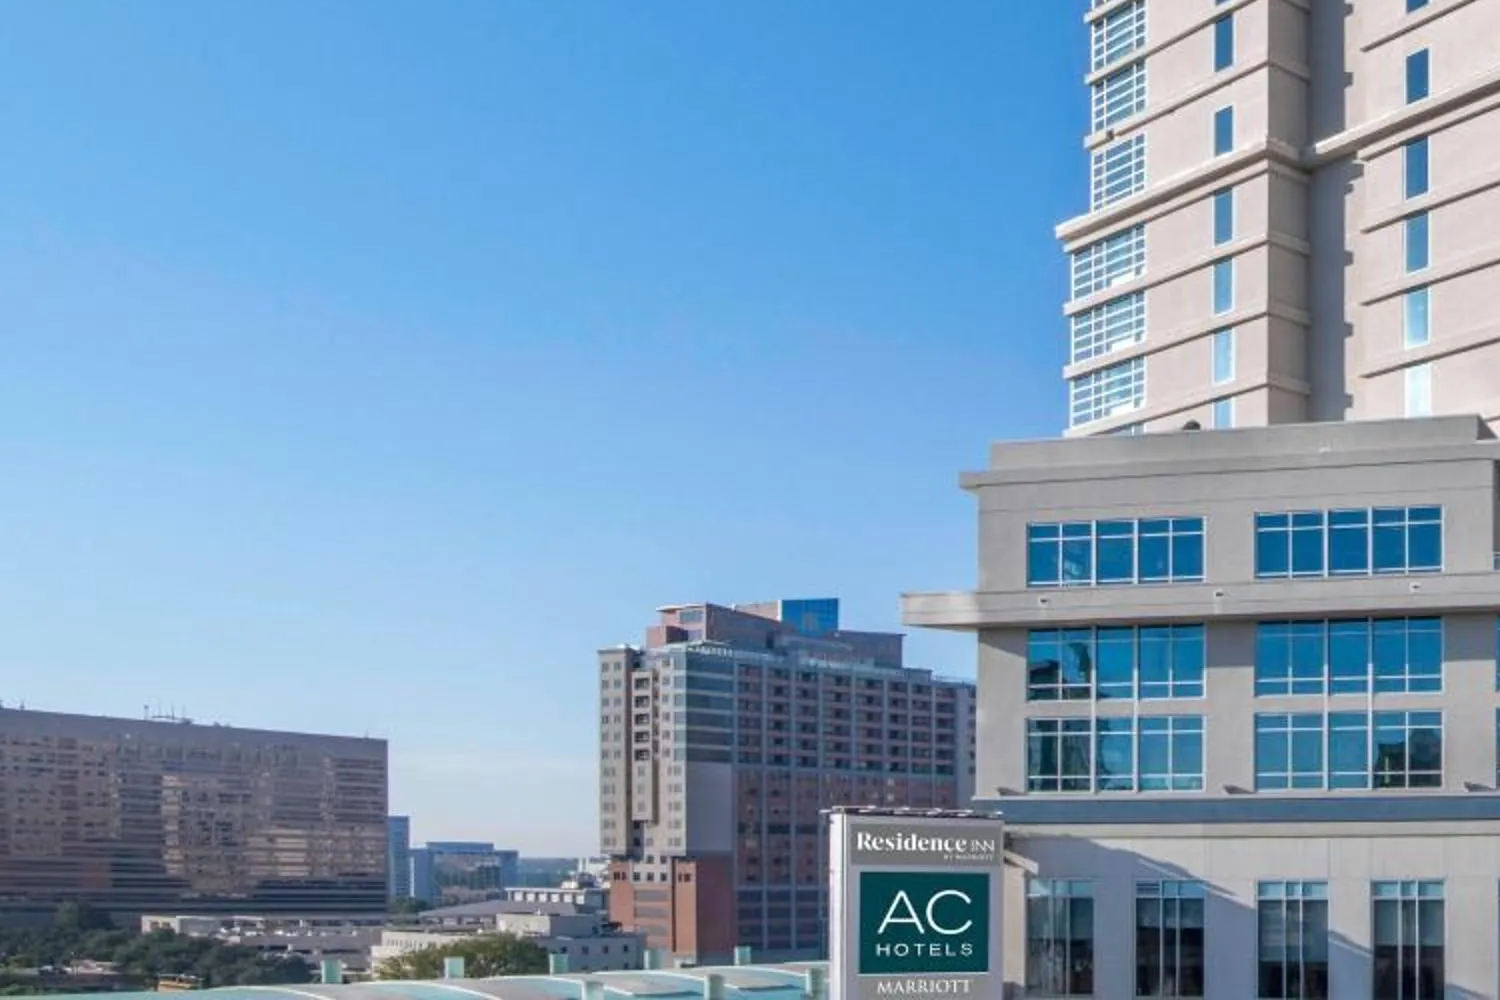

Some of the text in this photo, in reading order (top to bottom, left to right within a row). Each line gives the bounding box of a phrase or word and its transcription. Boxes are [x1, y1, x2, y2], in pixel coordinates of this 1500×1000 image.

[857, 832, 995, 852] Residence INN
[877, 890, 973, 935] AC
[876, 943, 973, 957] HOTELS
[877, 979, 970, 994] MARRIOTT
